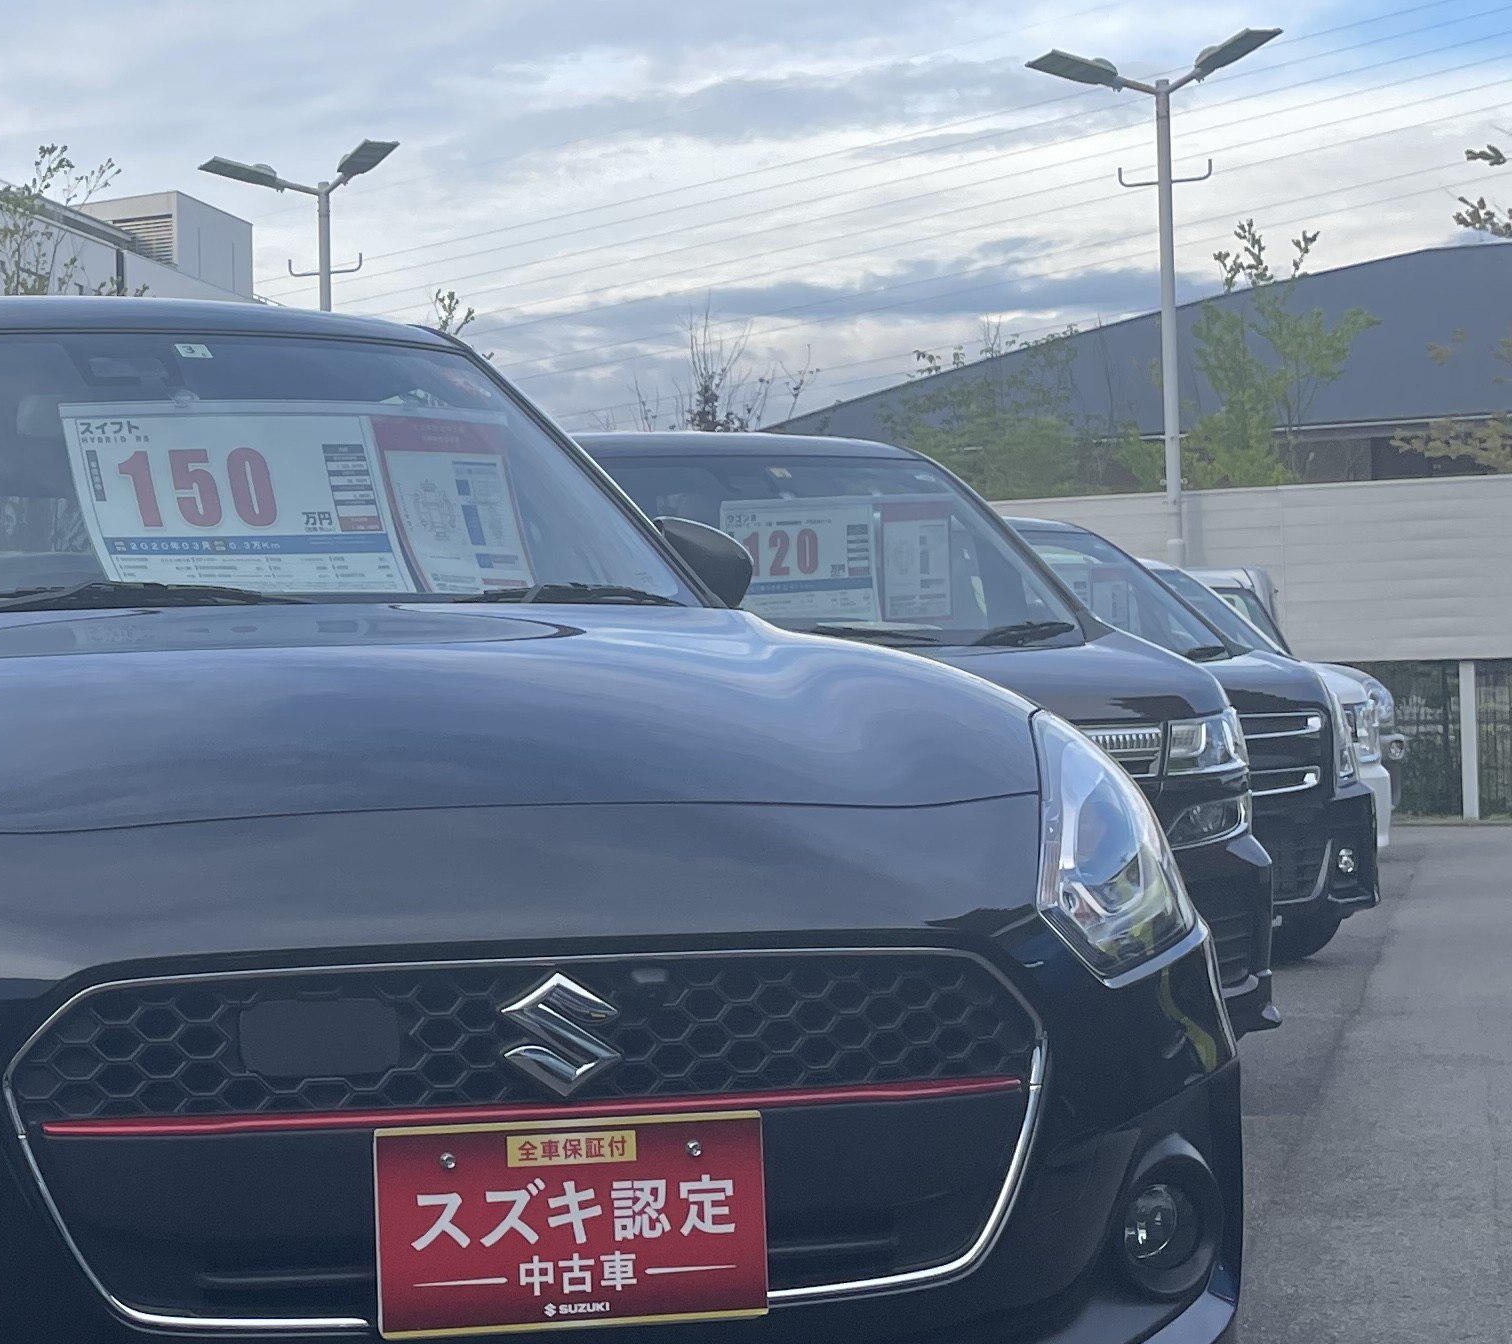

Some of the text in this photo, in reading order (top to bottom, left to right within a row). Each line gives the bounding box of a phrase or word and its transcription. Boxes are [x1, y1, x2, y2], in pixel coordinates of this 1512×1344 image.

[79, 420, 140, 435] スイフト
[117, 447, 279, 528] 150
[301, 511, 333, 526] 万円
[742, 527, 819, 577] 120
[517, 1135, 628, 1162] 全車保証付
[410, 1174, 736, 1252] スズキ認定
[518, 1250, 638, 1297] 中古車
[558, 1301, 611, 1315] SUZUKI
